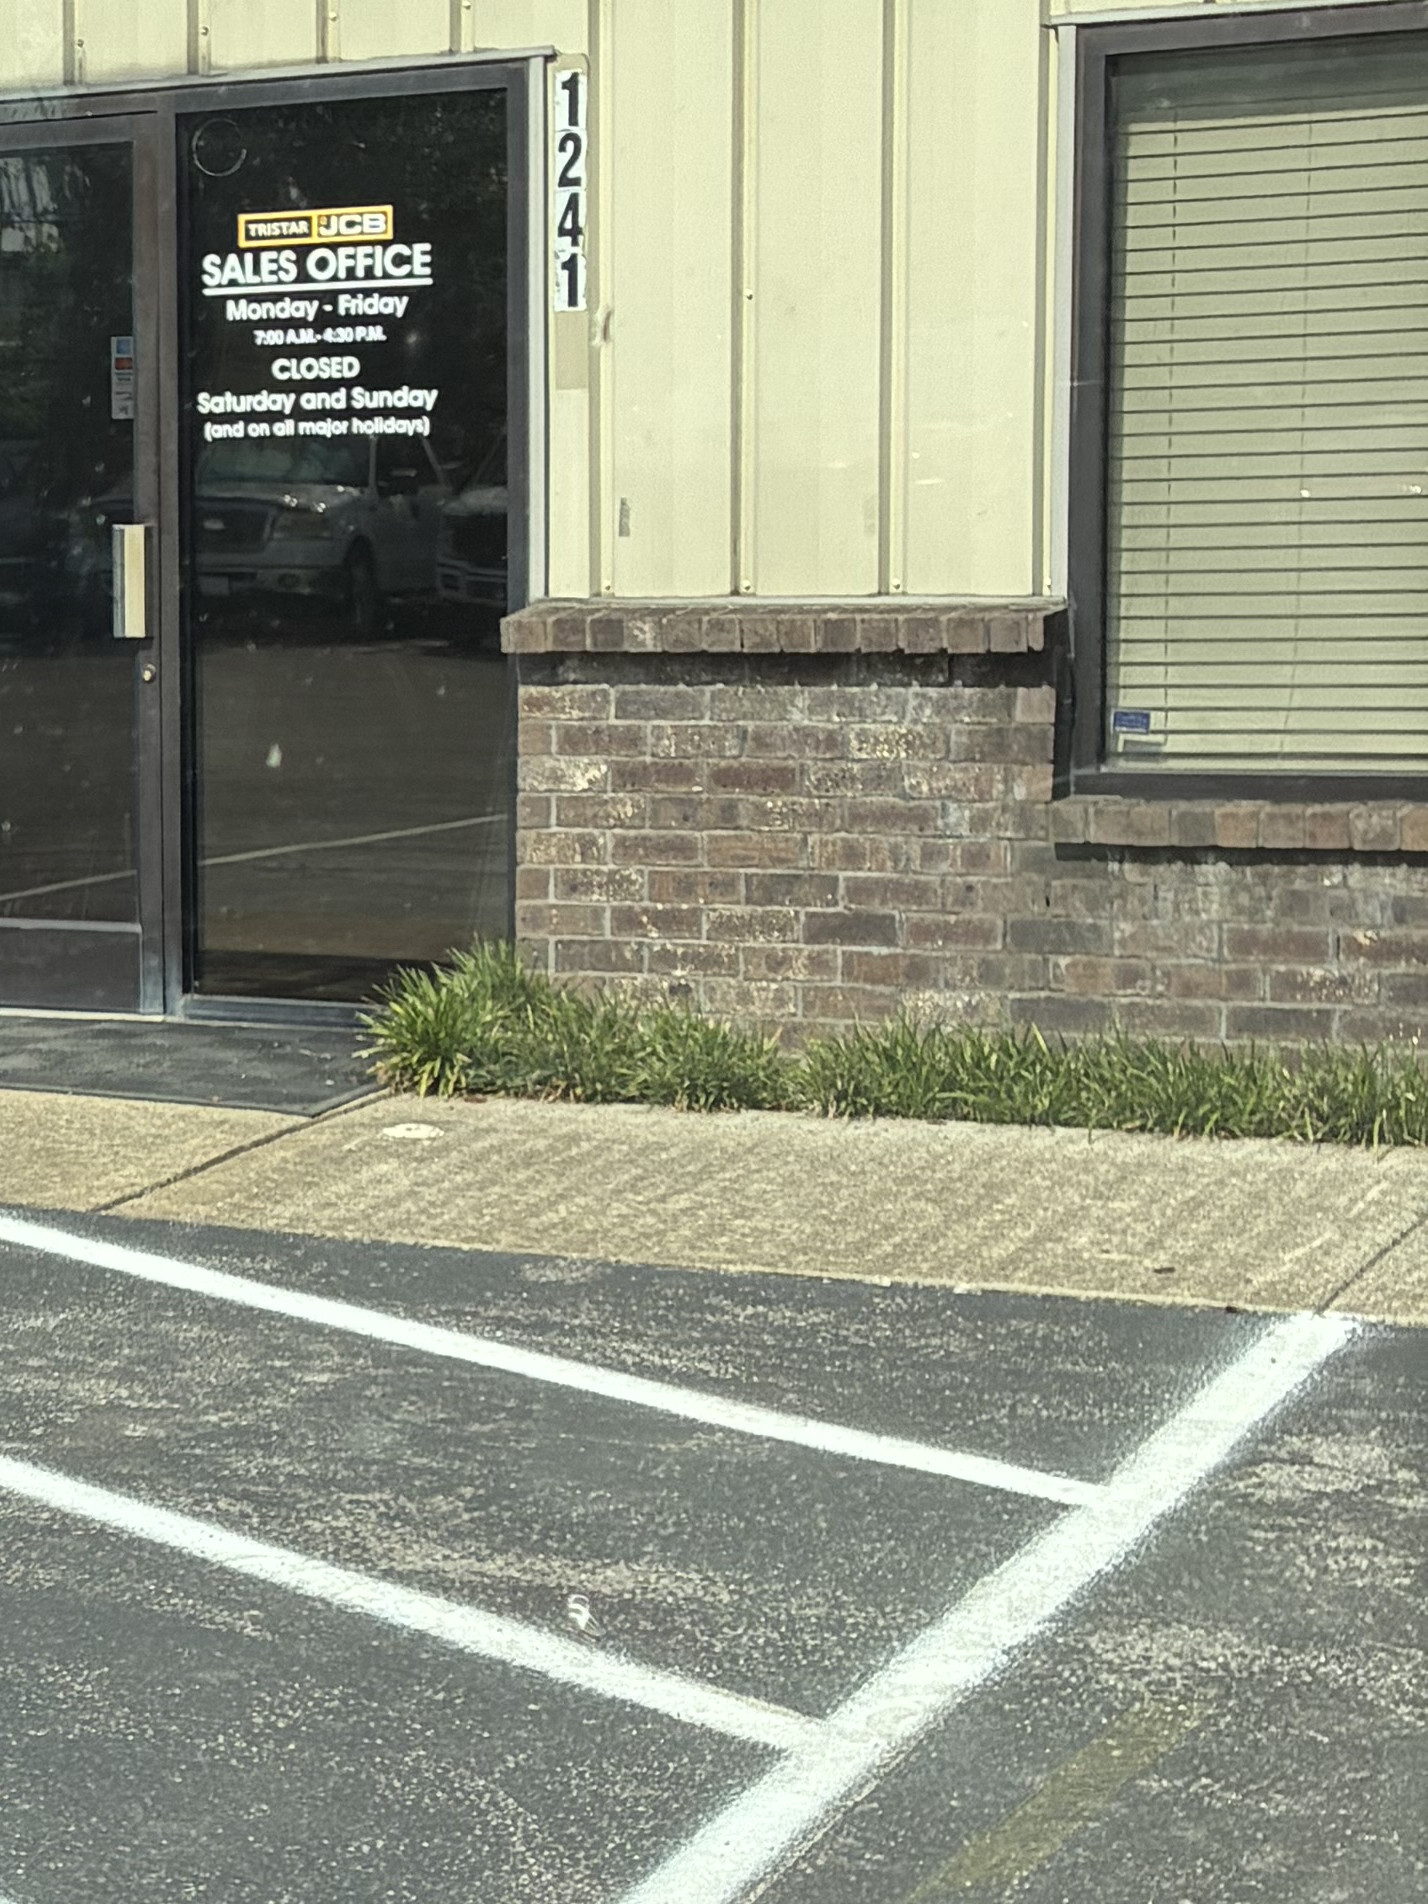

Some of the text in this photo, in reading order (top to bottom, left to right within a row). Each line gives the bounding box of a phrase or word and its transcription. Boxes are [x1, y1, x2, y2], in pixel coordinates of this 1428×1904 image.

[247, 212, 388, 238] TRISTAR JCB
[201, 242, 433, 287] SALES OFFICE
[225, 296, 320, 322] Monday
[337, 293, 410, 319] Friday
[270, 355, 361, 381] CLOSED
[196, 385, 439, 415] Saturday and Sunday
[203, 415, 431, 443] (and on all major holidays)
